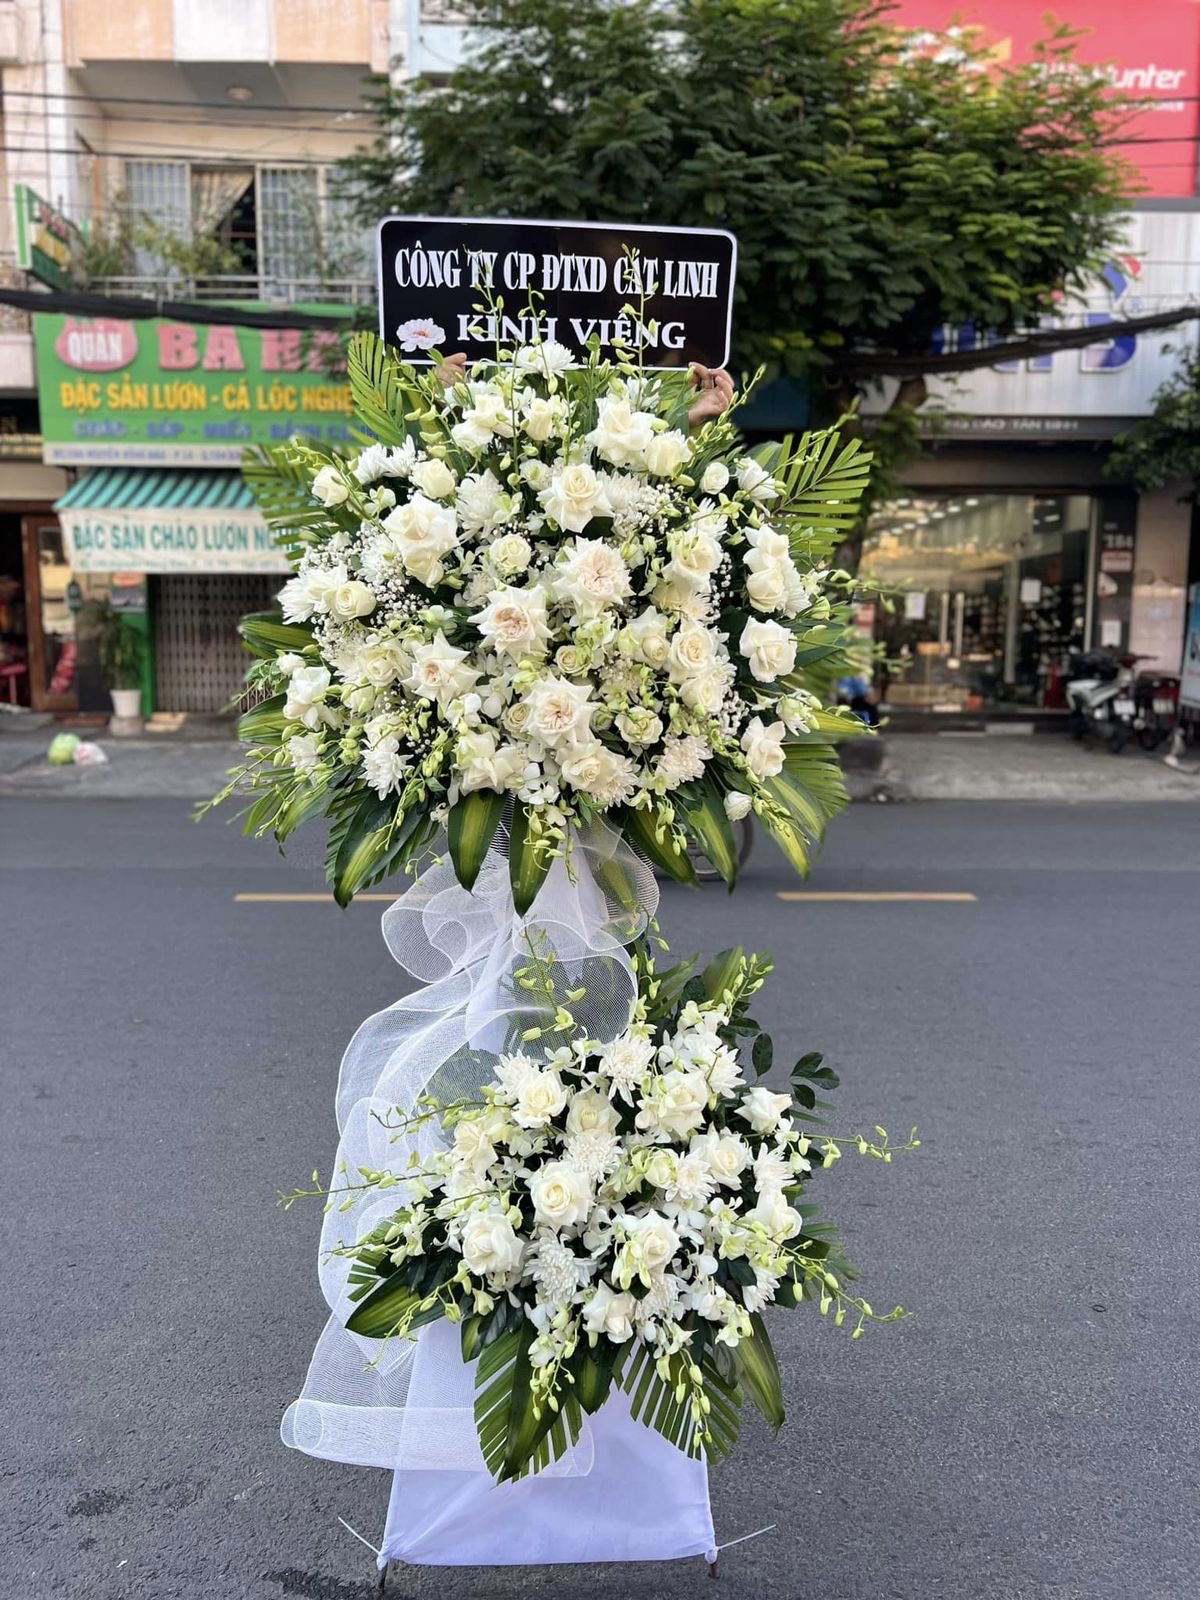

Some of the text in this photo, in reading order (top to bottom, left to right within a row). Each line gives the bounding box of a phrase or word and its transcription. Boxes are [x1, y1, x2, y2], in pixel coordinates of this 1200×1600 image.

[394, 240, 462, 288] CÔNG
[467, 250, 499, 288] TY
[503, 251, 536, 290] CP
[541, 252, 608, 293] ĐTXD
[662, 260, 720, 298] LINH
[157, 322, 246, 370] BA
[60, 376, 102, 415] ĐẶC
[107, 372, 149, 410] SẢN
[152, 379, 208, 411] LƯƠN
[222, 379, 251, 411] CÁ
